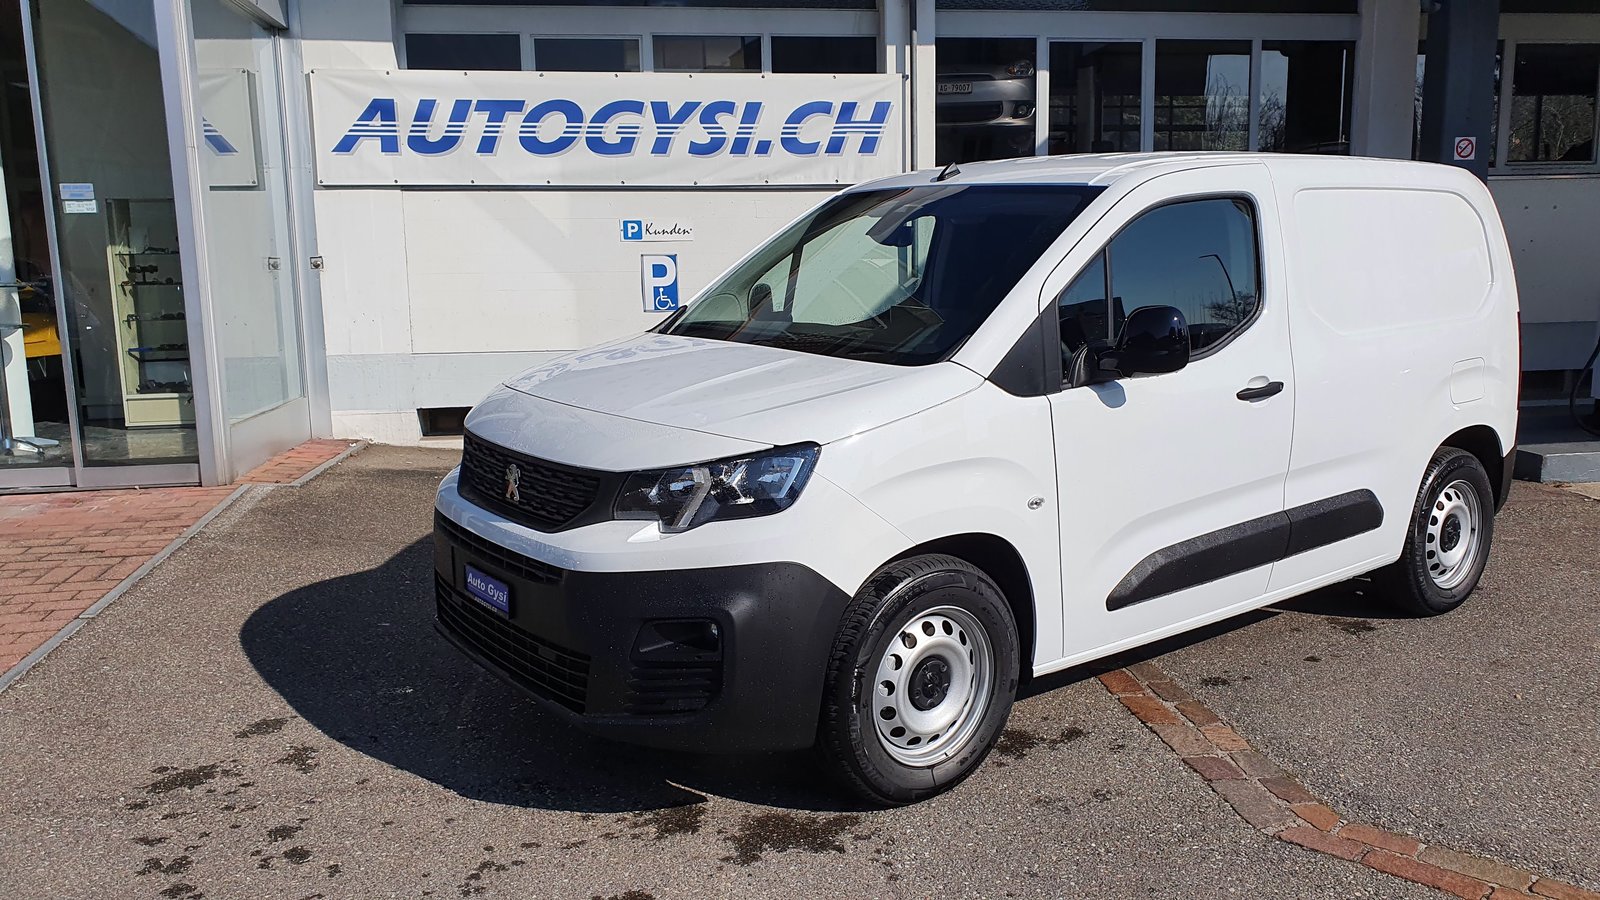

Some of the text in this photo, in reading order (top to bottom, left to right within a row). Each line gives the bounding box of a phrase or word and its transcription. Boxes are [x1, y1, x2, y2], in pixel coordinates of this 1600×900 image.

[332, 98, 892, 156] AUTOGYSI.CH
[627, 222, 690, 237] P Kunden
[644, 255, 676, 310] P
[467, 573, 507, 603] Auto Gysi
